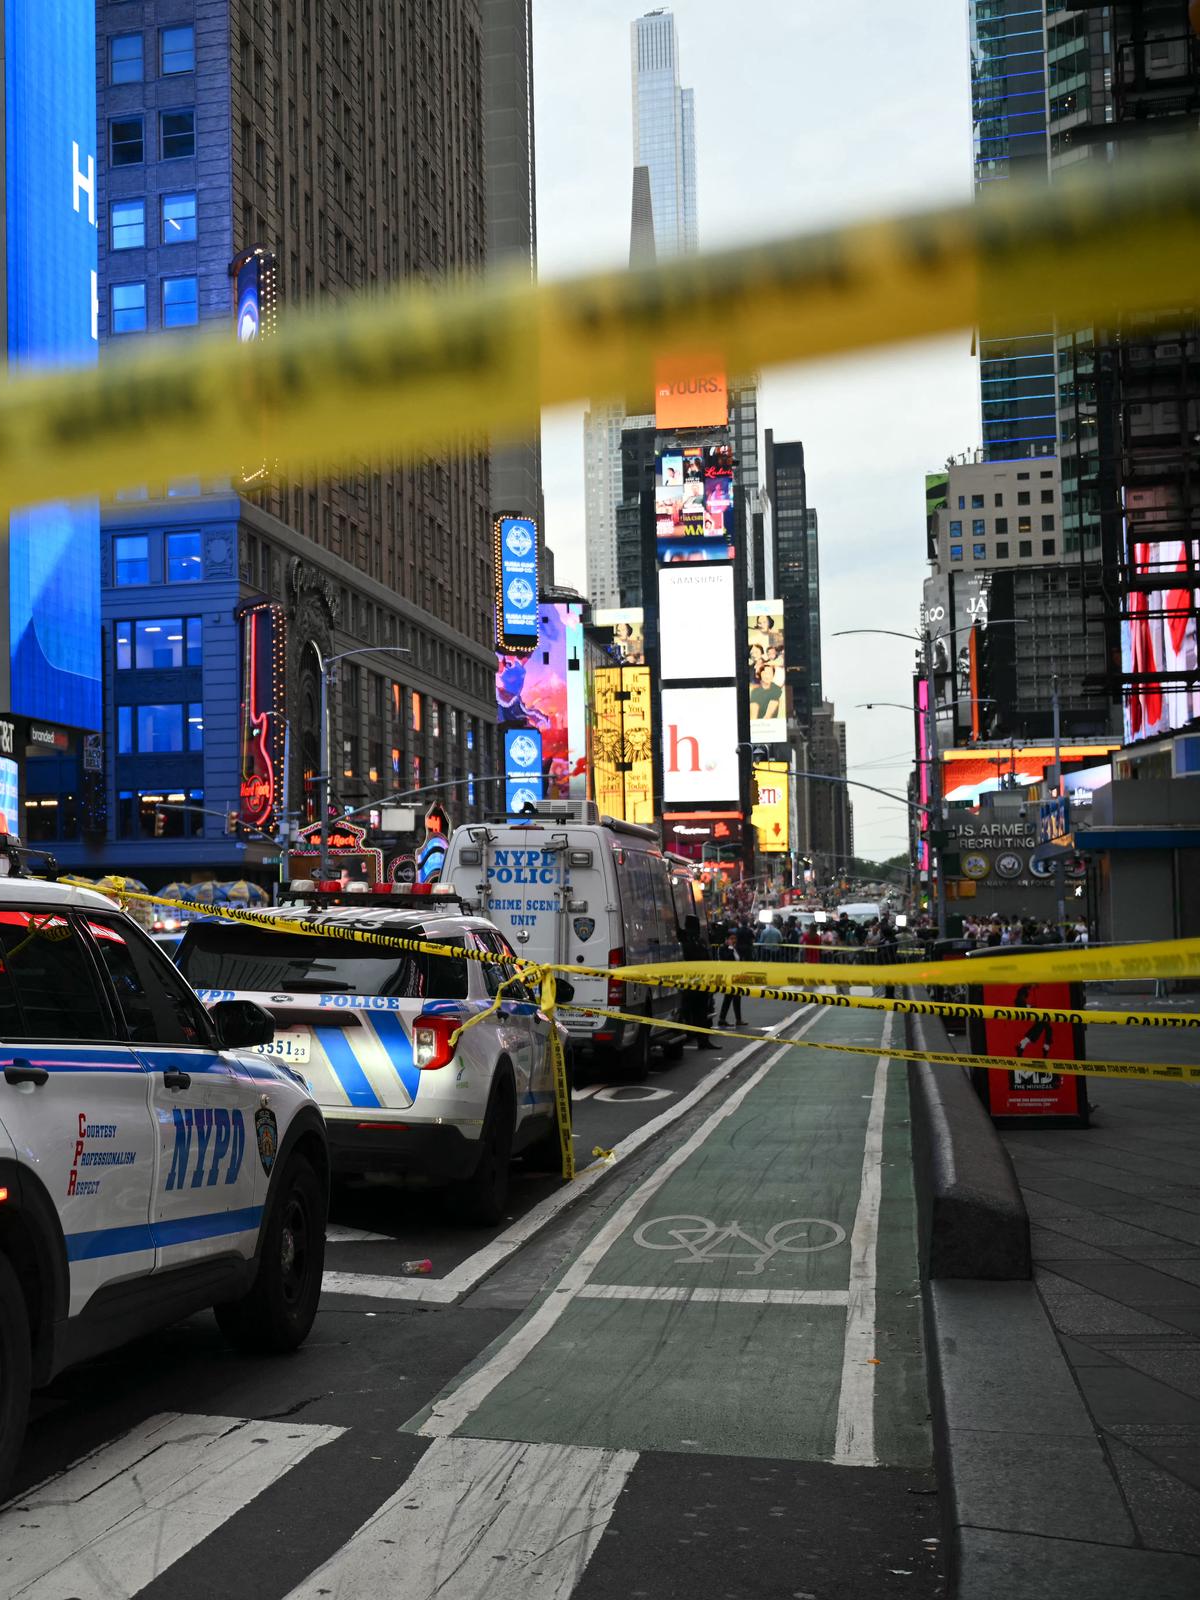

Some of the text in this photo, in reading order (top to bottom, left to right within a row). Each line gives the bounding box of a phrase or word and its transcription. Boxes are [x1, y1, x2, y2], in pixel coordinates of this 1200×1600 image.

[31, 727, 55, 744] branded
[981, 823, 1037, 836] ARMED
[310, 834, 356, 847] Had Rock
[959, 837, 1036, 849] RECRUITING
[494, 850, 559, 867] NYPD
[488, 899, 560, 912] CRIME SCENE
[510, 915, 537, 926] UNIT
[194, 989, 400, 1010] YPD POLICE
[164, 1108, 246, 1192] NYPD
